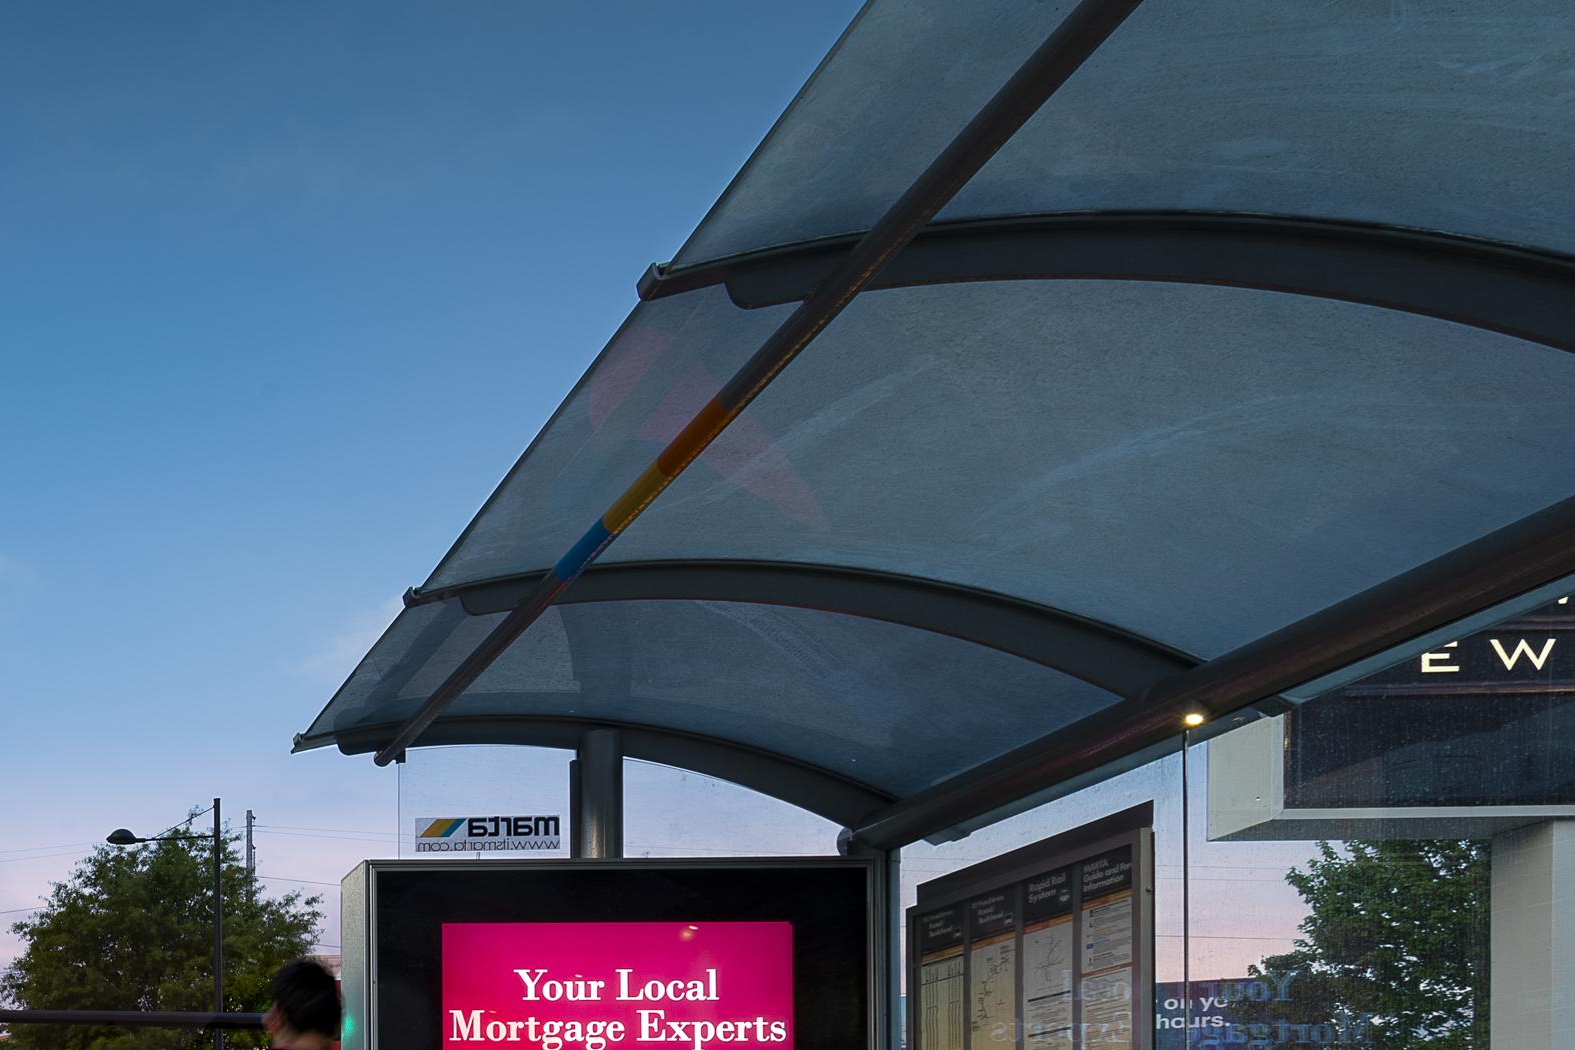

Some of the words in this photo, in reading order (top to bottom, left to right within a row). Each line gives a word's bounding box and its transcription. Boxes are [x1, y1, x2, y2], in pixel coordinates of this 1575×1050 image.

[1028, 879, 1050, 893] Rapid
[1051, 873, 1066, 885] Rail
[1028, 889, 1057, 904] System
[514, 969, 605, 1001] Your
[615, 969, 719, 1001] Local
